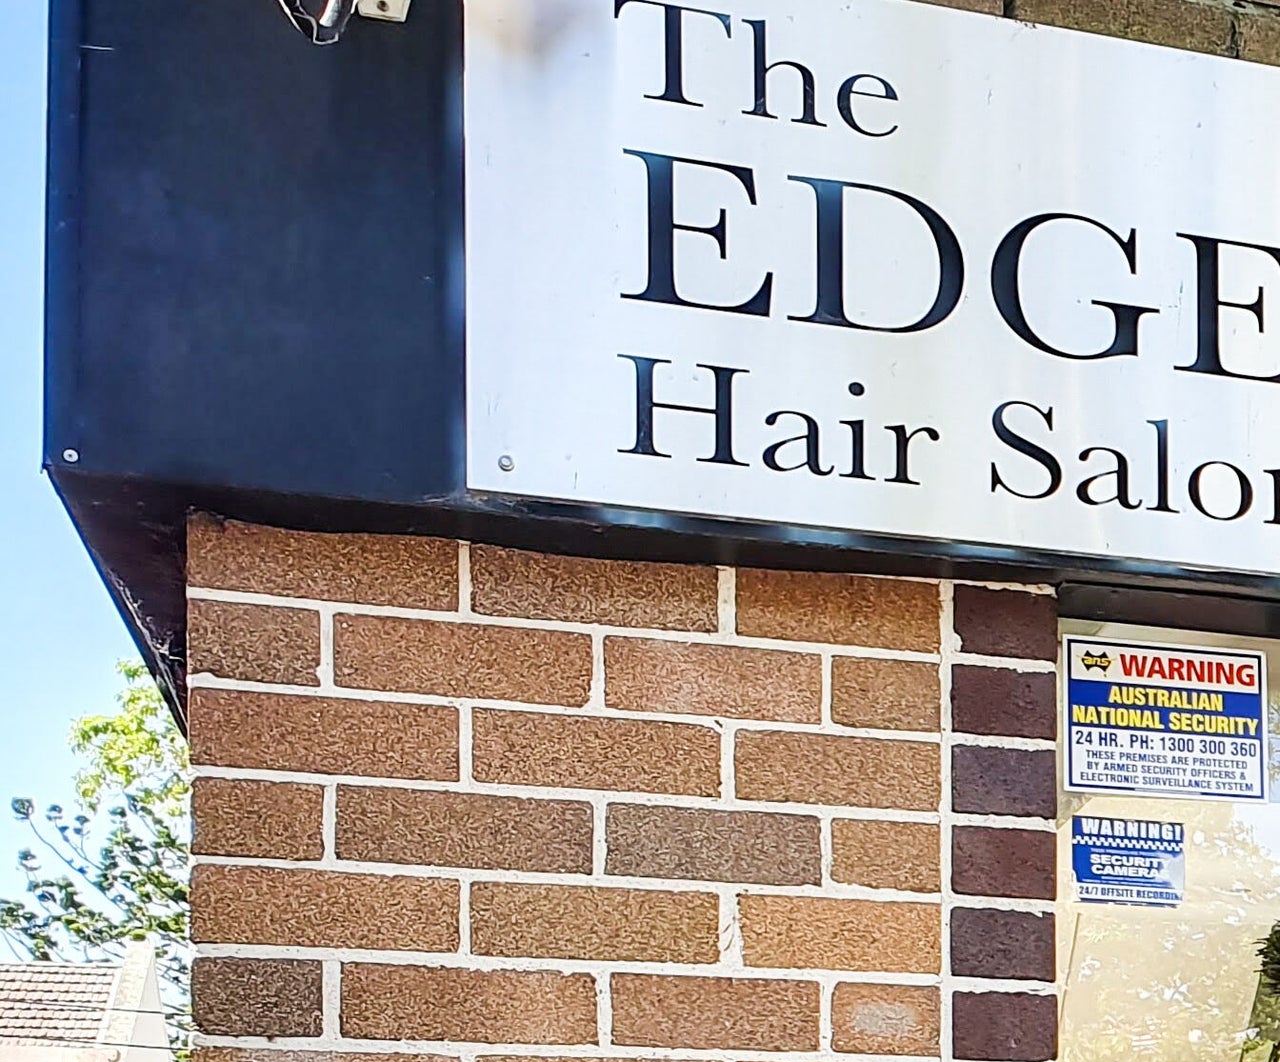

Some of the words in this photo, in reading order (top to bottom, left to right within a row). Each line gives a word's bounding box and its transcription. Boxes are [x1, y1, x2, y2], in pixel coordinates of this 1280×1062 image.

[613, 0, 899, 137] The
[616, 353, 940, 487] Hair
[1119, 653, 1256, 687] WARNING
[1108, 685, 1224, 712] AUSTRALIAN
[1072, 704, 1165, 730] NATIONAL
[1168, 712, 1259, 736] SECURITY
[1075, 730, 1093, 745] 24
[1098, 732, 1124, 748] HR.
[1129, 734, 1155, 750] PH:
[1159, 737, 1195, 753] 1300
[1199, 739, 1226, 755] 300
[1230, 742, 1257, 757] 360
[1086, 750, 1117, 760] THESE
[1119, 752, 1168, 764] PREMISES
[1171, 755, 1190, 765] ARE
[1193, 757, 1248, 769] PROTECTED
[1087, 760, 1099, 770] BY
[1103, 762, 1138, 773] ARMED
[1141, 765, 1187, 777] SECURITY
[1190, 768, 1236, 780] OFFICERS
[1239, 772, 1246, 780] &
[1080, 772, 1140, 784] ELECTRONIC
[1142, 776, 1213, 789] SURVEILLANCE
[1215, 781, 1254, 792] SYSTEM
[1081, 818, 1183, 841] WARNING!
[1090, 853, 1170, 869] SECURITY
[1079, 886, 1099, 896] 24/7
[1101, 887, 1134, 898] OFFSITE
